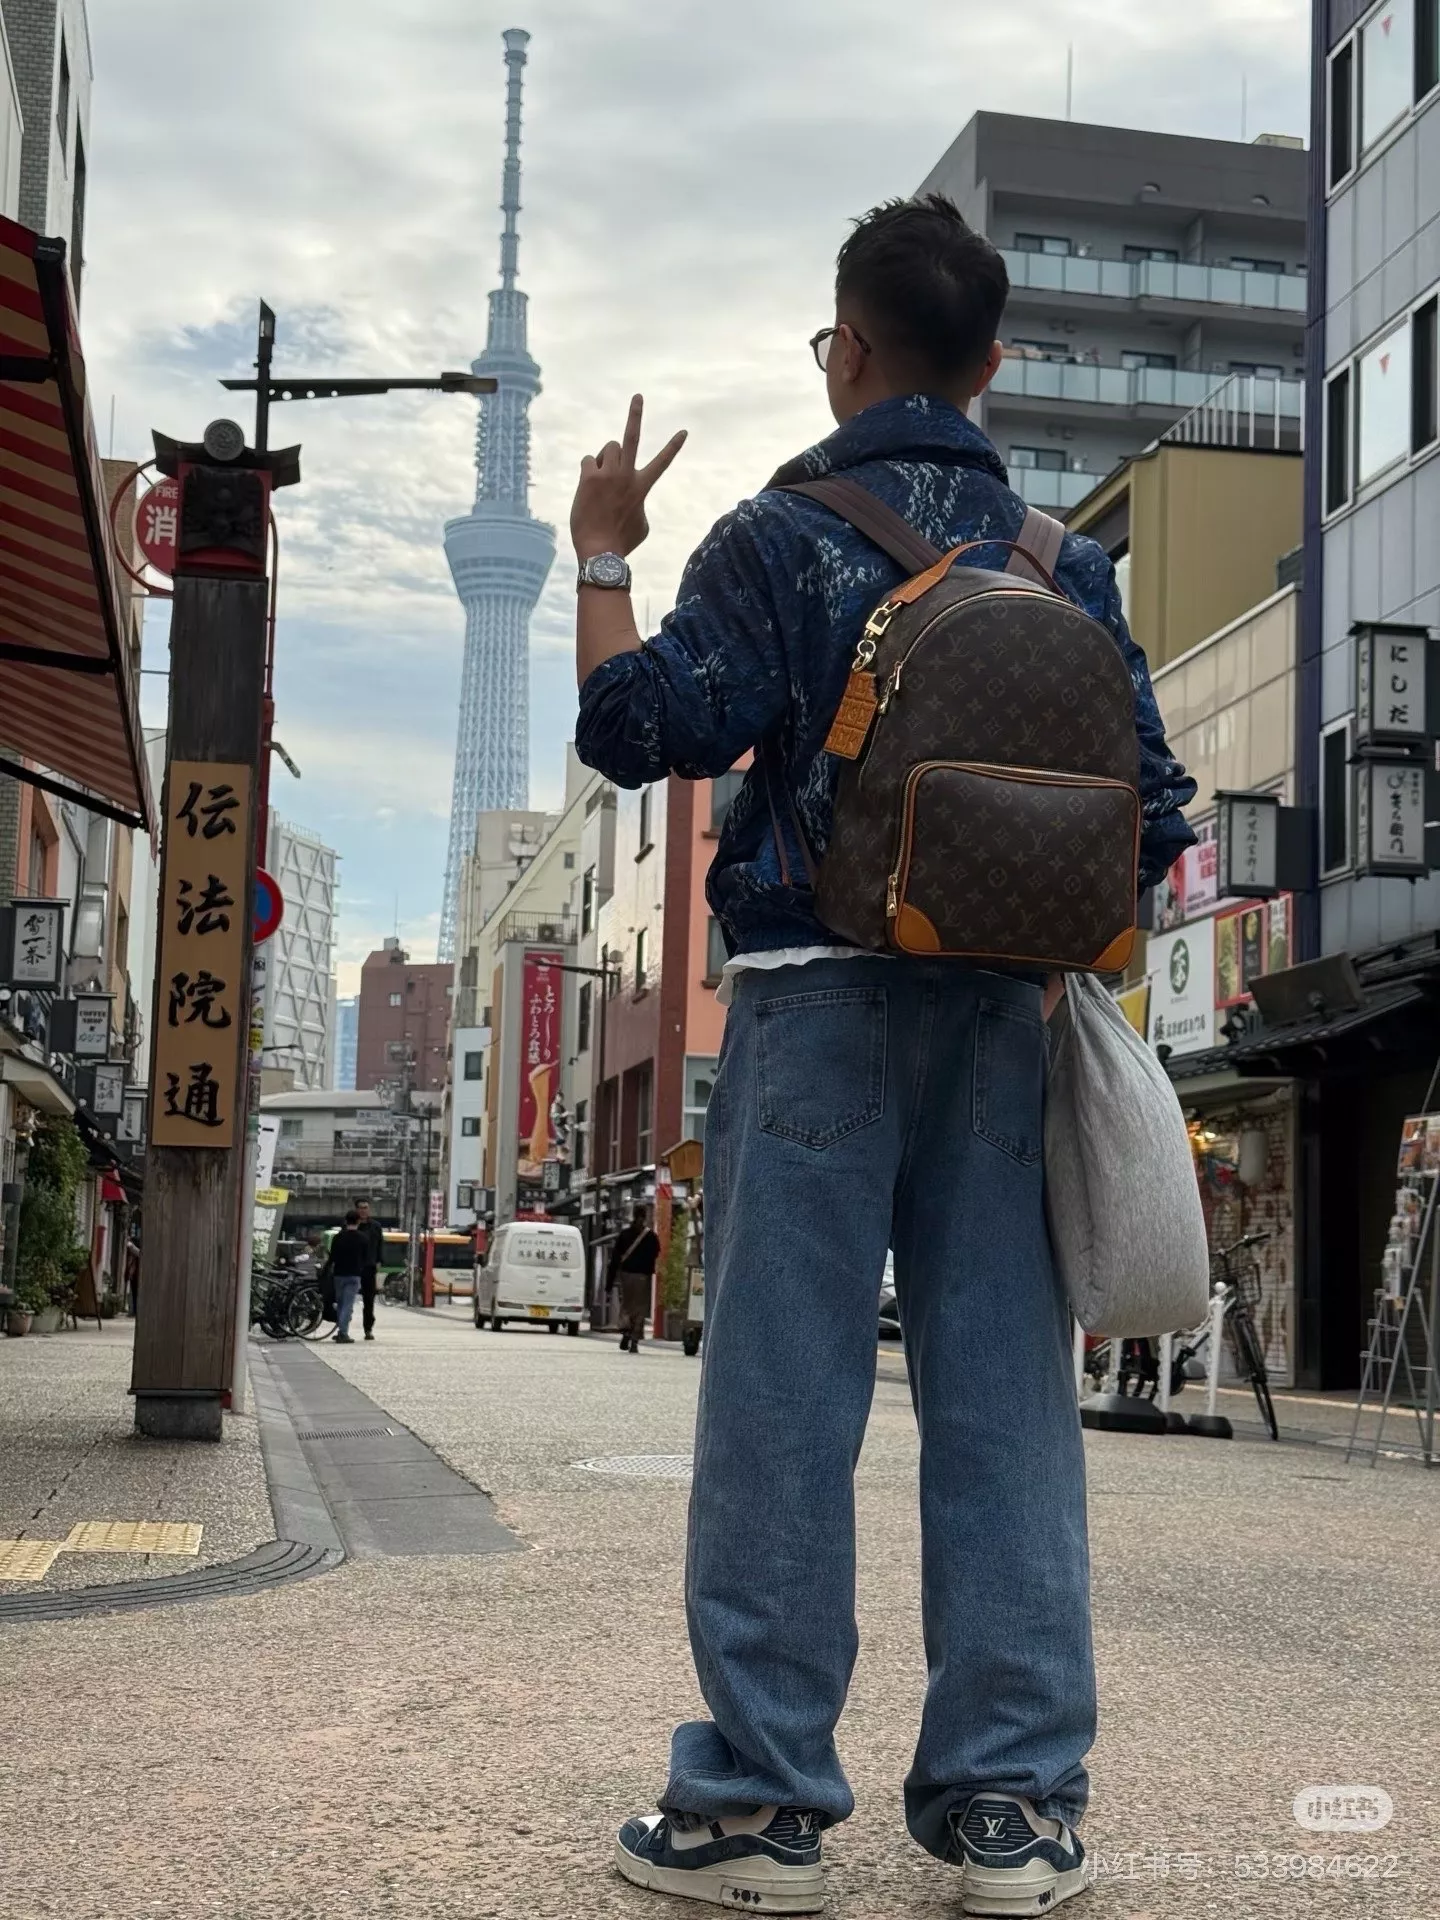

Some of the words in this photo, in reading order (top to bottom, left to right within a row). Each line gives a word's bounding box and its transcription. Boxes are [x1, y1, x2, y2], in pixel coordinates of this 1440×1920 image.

[155, 485, 179, 499] FIRE
[1389, 644, 1409, 724] にしだ
[164, 781, 241, 1127] 伝法院通
[79, 1010, 107, 1018] COFFEE
